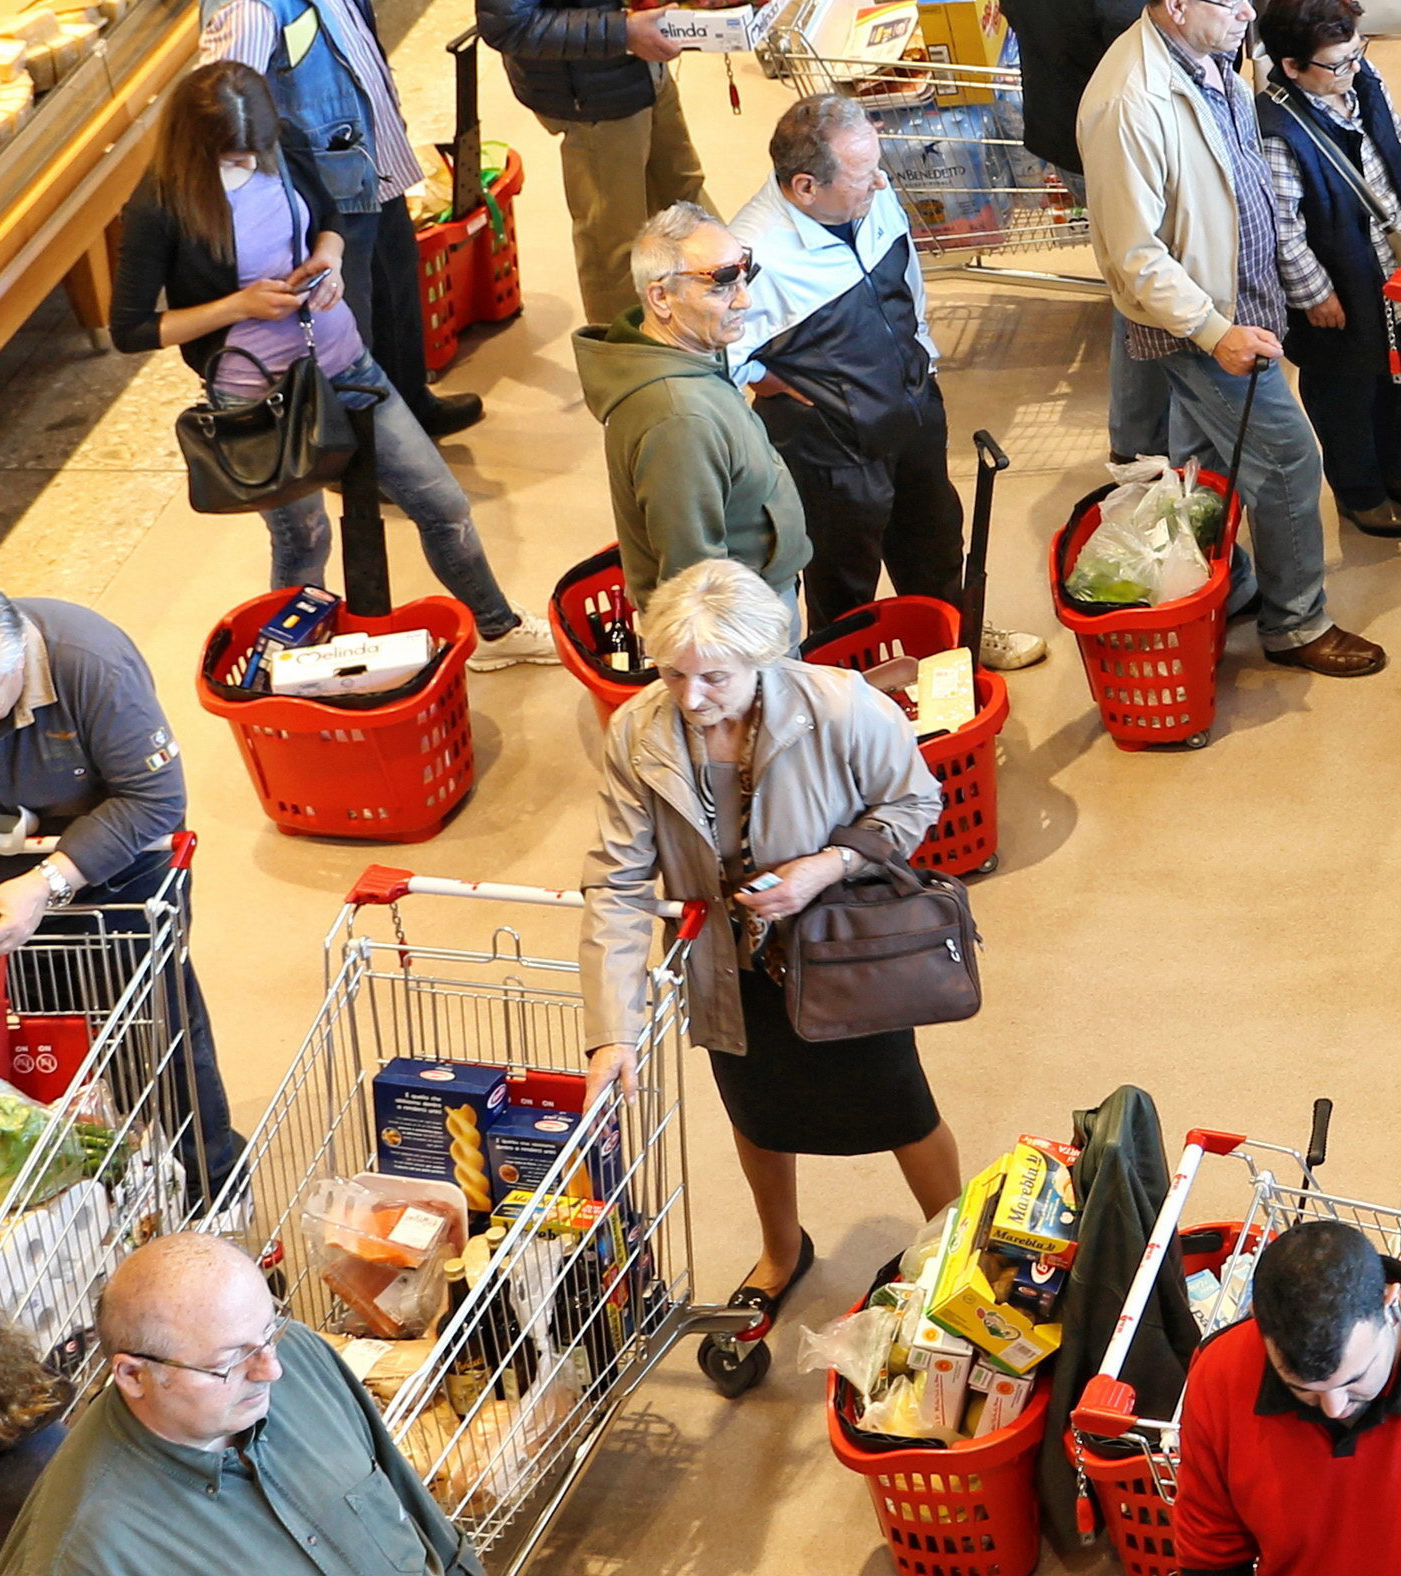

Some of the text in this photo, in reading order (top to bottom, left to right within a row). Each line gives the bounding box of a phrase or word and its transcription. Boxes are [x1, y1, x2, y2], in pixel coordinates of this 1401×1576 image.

[656, 23, 707, 38] elinda
[297, 643, 380, 664] Melinda
[1008, 1166, 1039, 1225] Mareblu
[992, 1229, 1044, 1251] Mareblu
